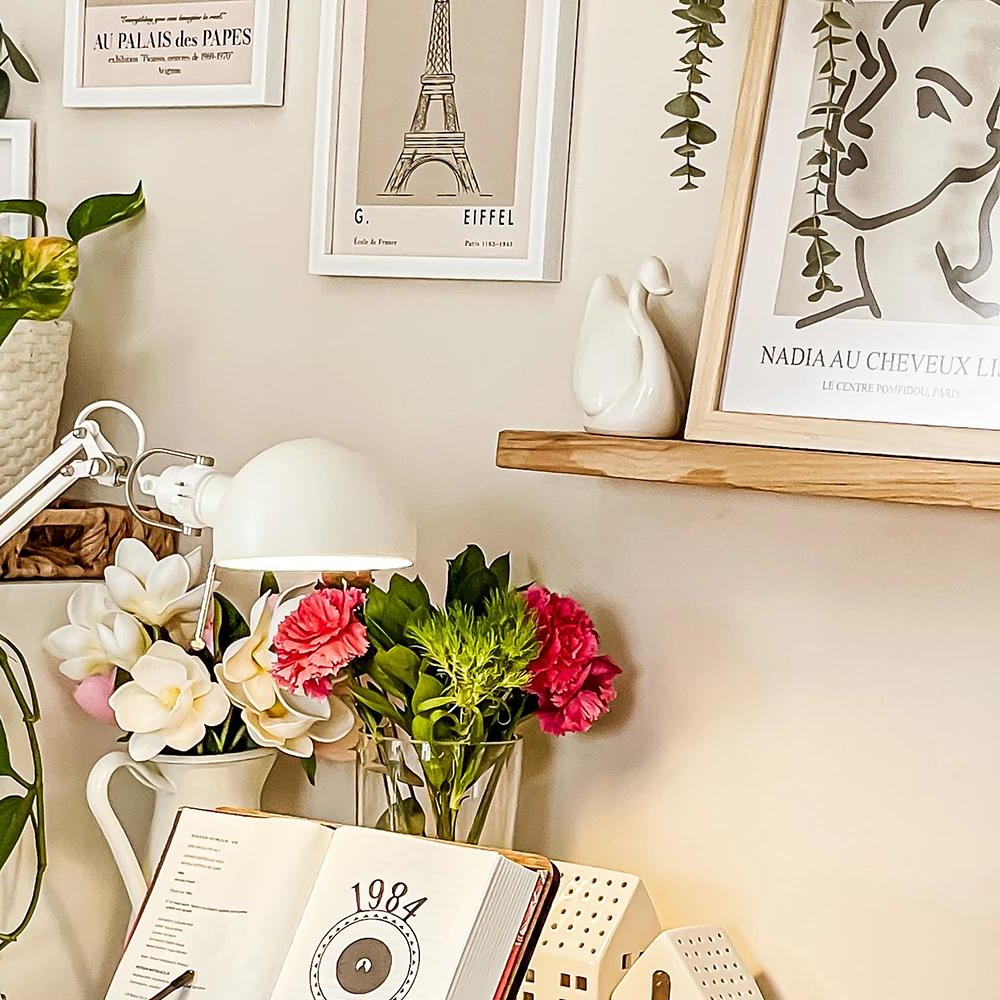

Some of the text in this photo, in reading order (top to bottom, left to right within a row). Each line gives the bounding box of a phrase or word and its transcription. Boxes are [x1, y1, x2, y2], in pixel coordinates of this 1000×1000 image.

[94, 28, 252, 50] AU PALAIS des PAPES
[354, 208, 514, 226] G. EIFFEL
[760, 345, 1000, 378] NADIA AU CHEVEUX LI
[822, 380, 834, 391] LE
[836, 381, 874, 394] CENTRE
[932, 388, 960, 399] PARIS
[351, 878, 428, 922] 1984
